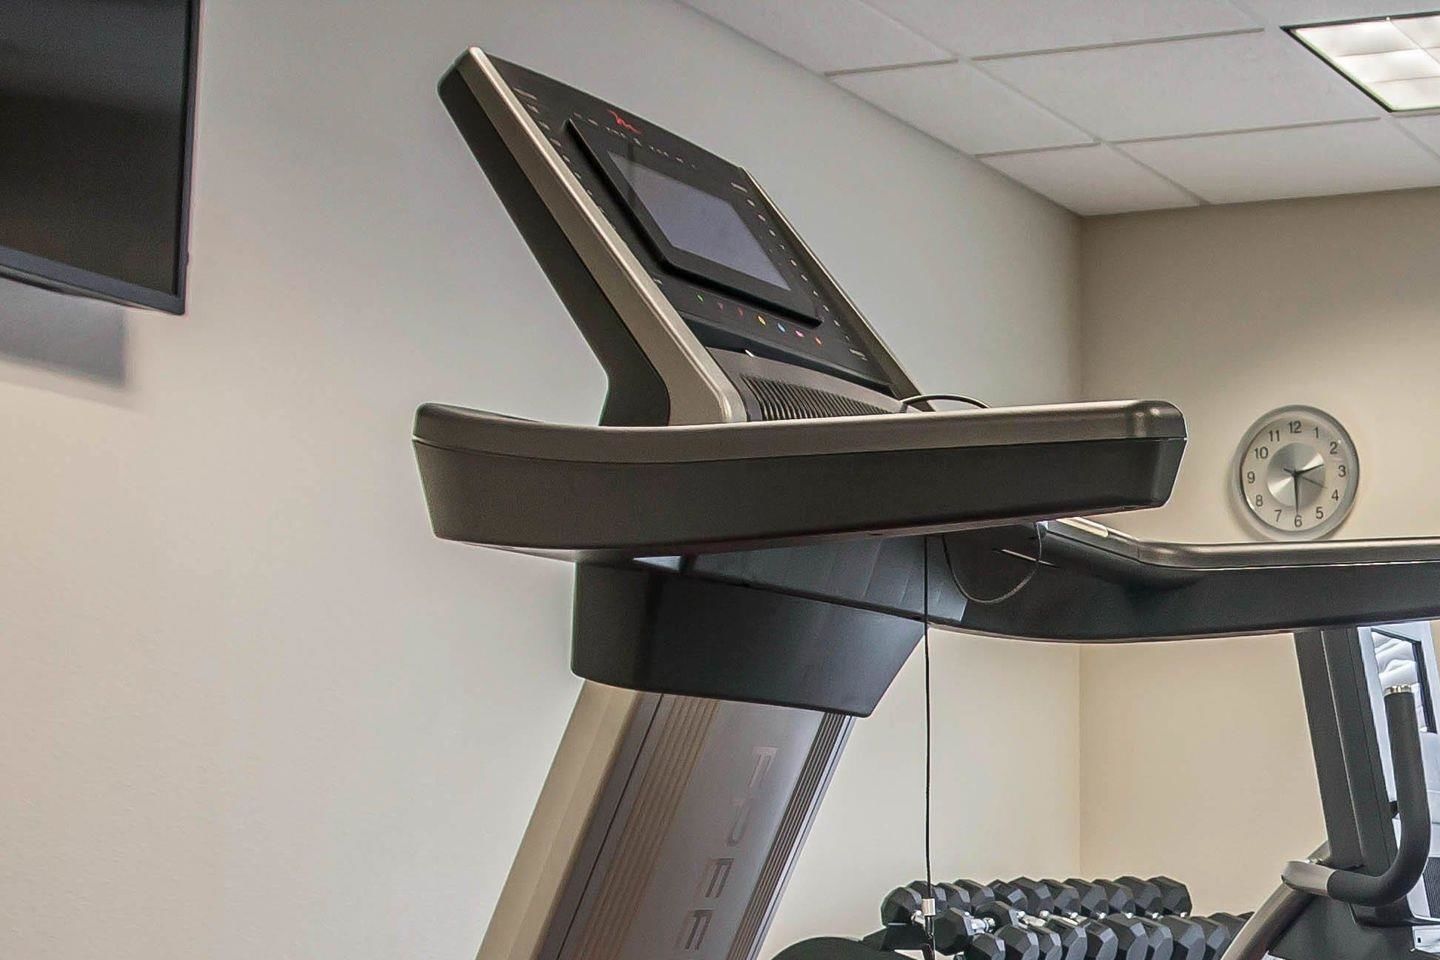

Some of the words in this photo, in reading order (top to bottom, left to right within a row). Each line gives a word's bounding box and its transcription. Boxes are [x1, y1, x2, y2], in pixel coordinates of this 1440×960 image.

[1288, 420, 1302, 433] 12
[1268, 430, 1280, 442] 11
[1254, 446, 1269, 459] 10
[1329, 441, 1338, 454] 2
[1338, 464, 1346, 477] 3
[1247, 471, 1255, 484] 9
[1255, 494, 1263, 507] 8
[1331, 489, 1339, 501] 4
[1274, 509, 1282, 522] 7
[1315, 506, 1324, 519] 5
[1294, 515, 1302, 527] 6
